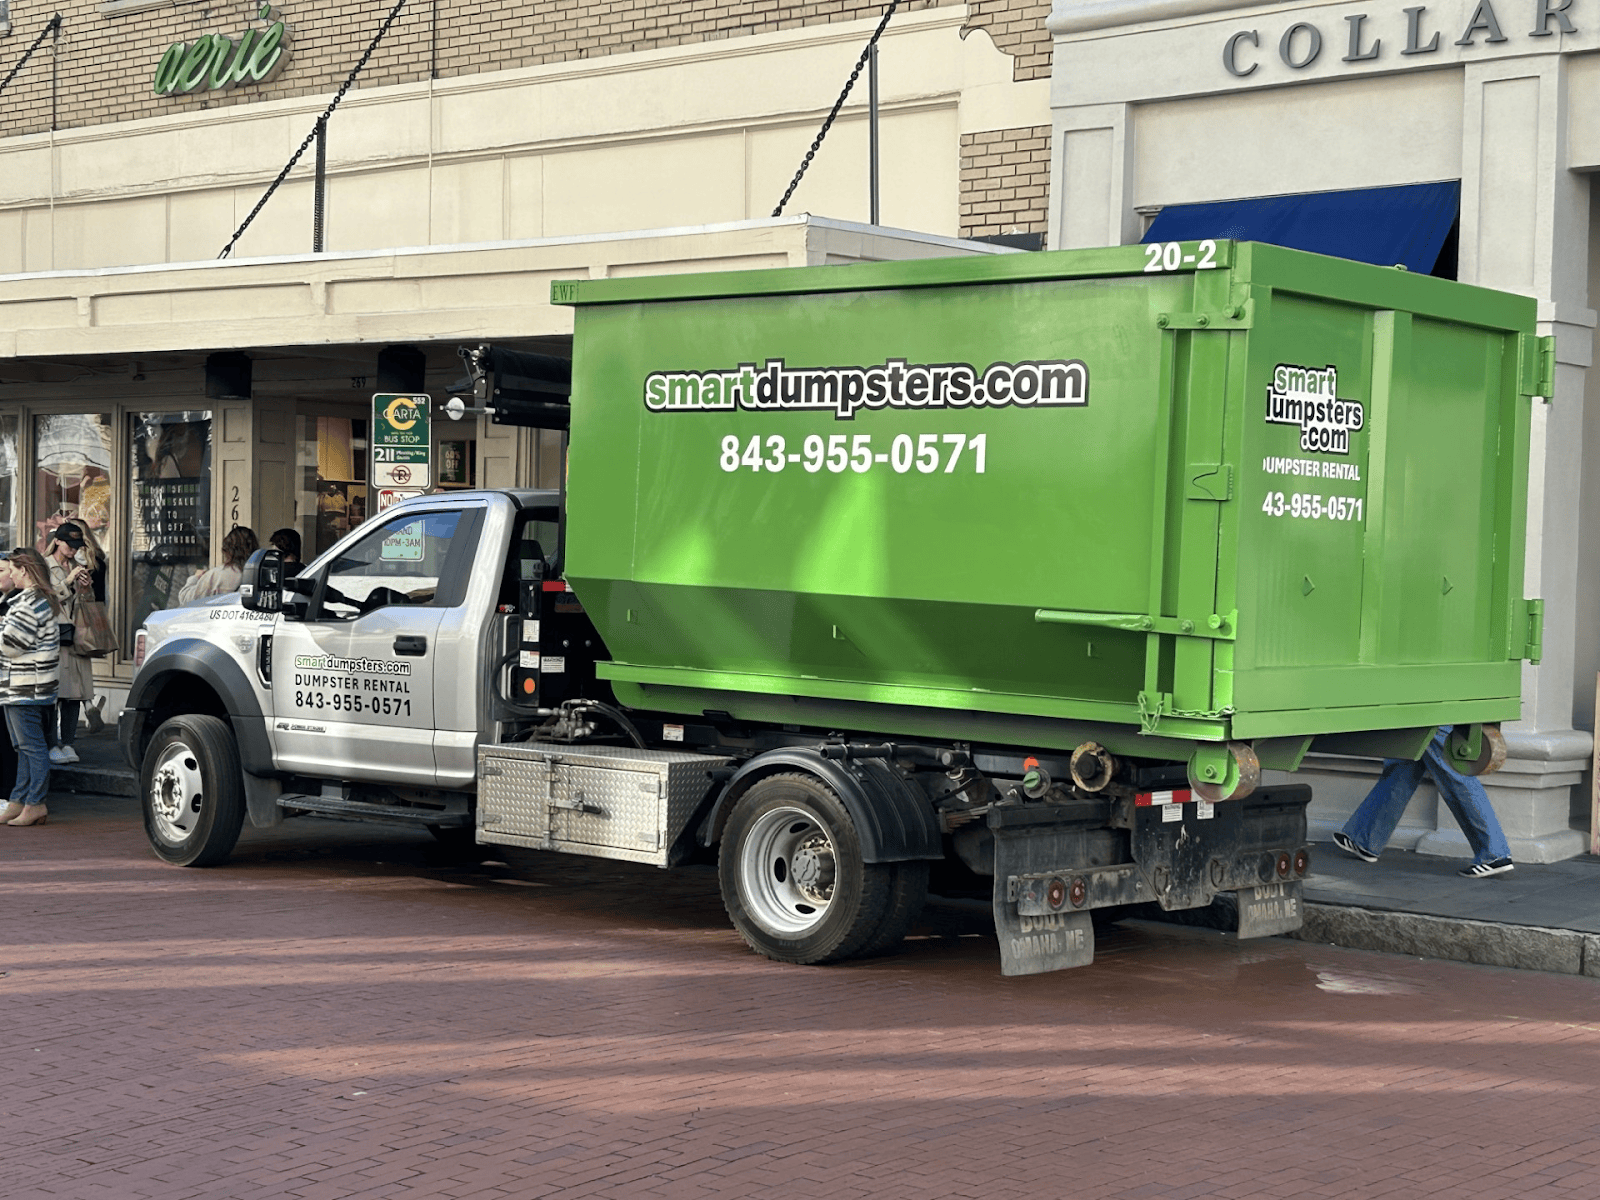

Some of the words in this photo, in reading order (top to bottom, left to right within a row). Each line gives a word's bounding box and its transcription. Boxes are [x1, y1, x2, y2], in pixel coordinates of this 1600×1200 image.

[1222, 0, 1578, 77] COLLAR
[153, 4, 285, 95] aerie
[1143, 239, 1217, 272] 20-2
[552, 284, 575, 301] EWF
[645, 359, 1089, 420] smartdumpsters.com
[1274, 365, 1337, 396] smart
[384, 434, 399, 443] BUS
[400, 434, 420, 443] STOP
[374, 447, 395, 462] 211
[719, 433, 988, 474] 843-955-0571
[1322, 461, 1361, 482] RENTAL
[172, 497, 194, 506] SALE
[380, 493, 393, 507] NO
[209, 609, 222, 620] US
[221, 610, 240, 620] DOT
[295, 655, 411, 675] smartdumpsters.com
[295, 674, 359, 690] DUMPSTER
[363, 679, 410, 693] RENTAL
[295, 690, 411, 717] 843-955-0571
